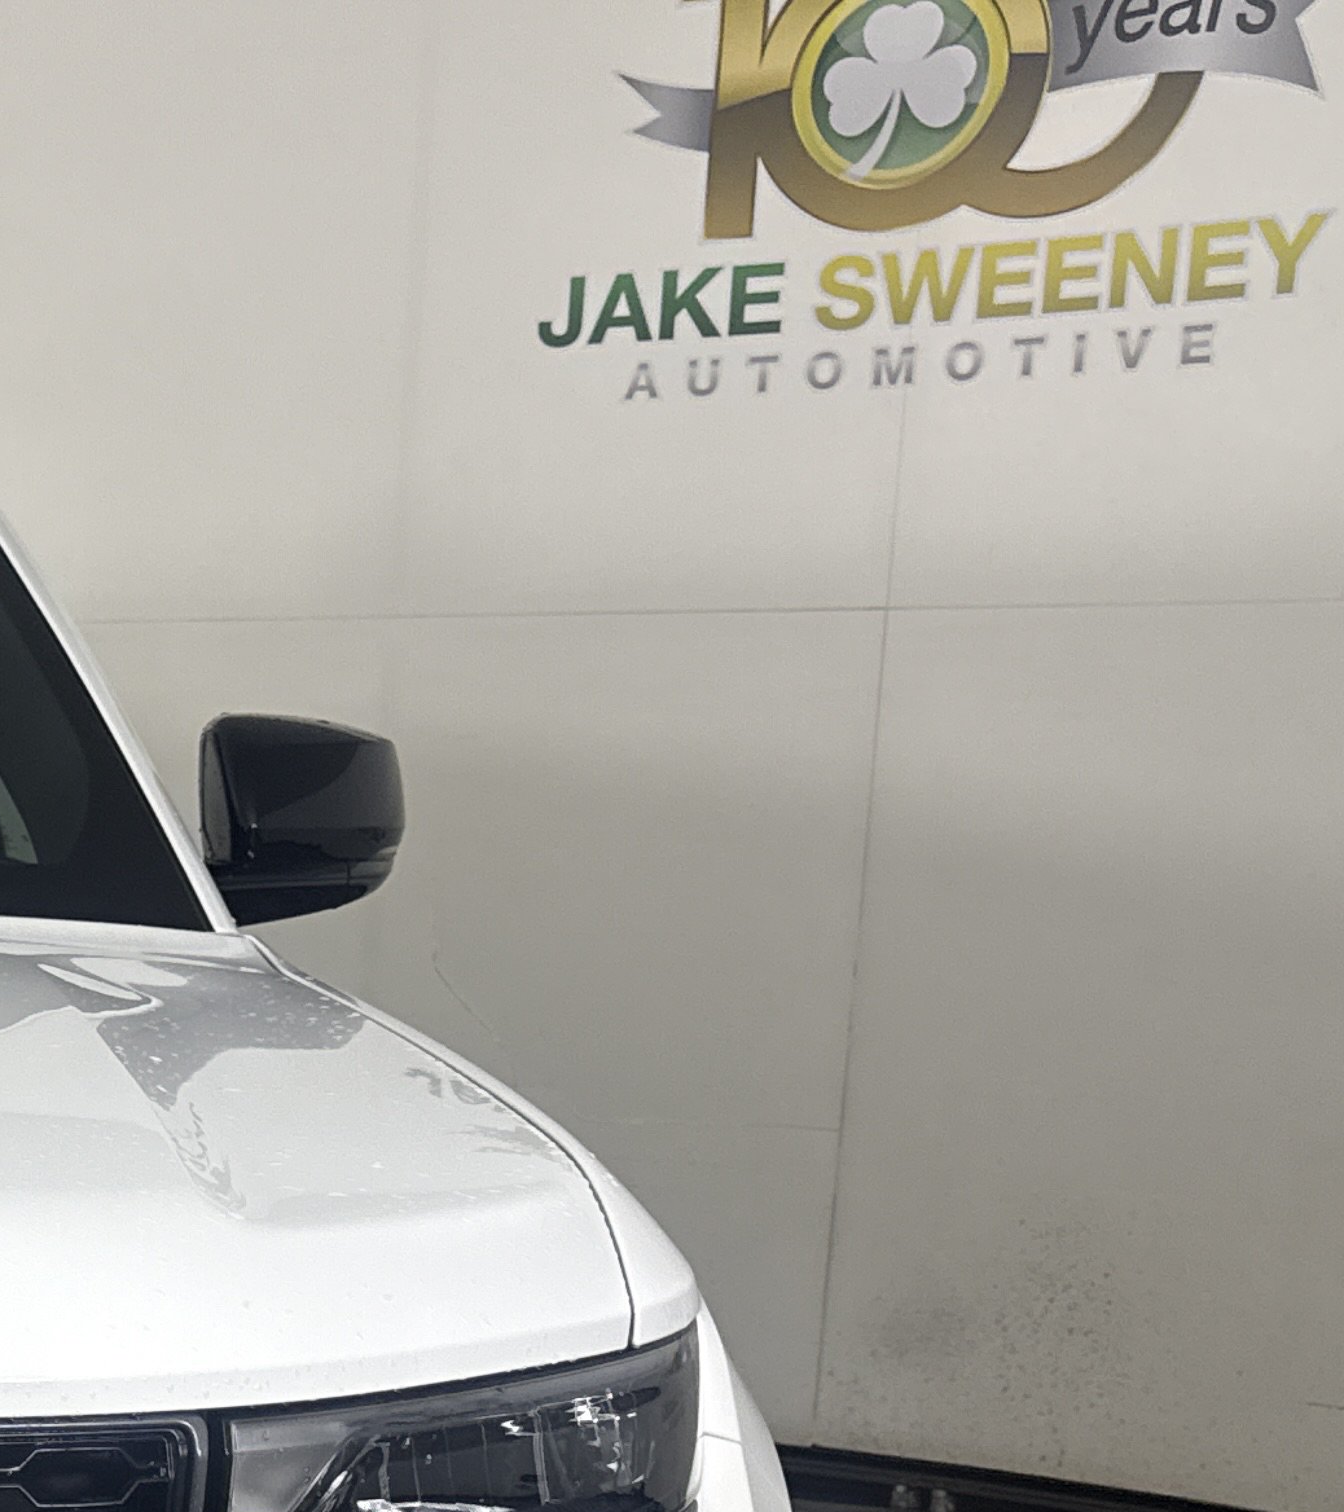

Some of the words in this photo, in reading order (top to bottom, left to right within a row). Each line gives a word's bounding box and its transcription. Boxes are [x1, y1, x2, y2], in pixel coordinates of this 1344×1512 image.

[1064, 0, 1277, 75] years
[537, 262, 785, 348] JAKE
[815, 212, 1326, 331] SWEENEY
[625, 323, 1217, 401] AUTOMOTIVE
